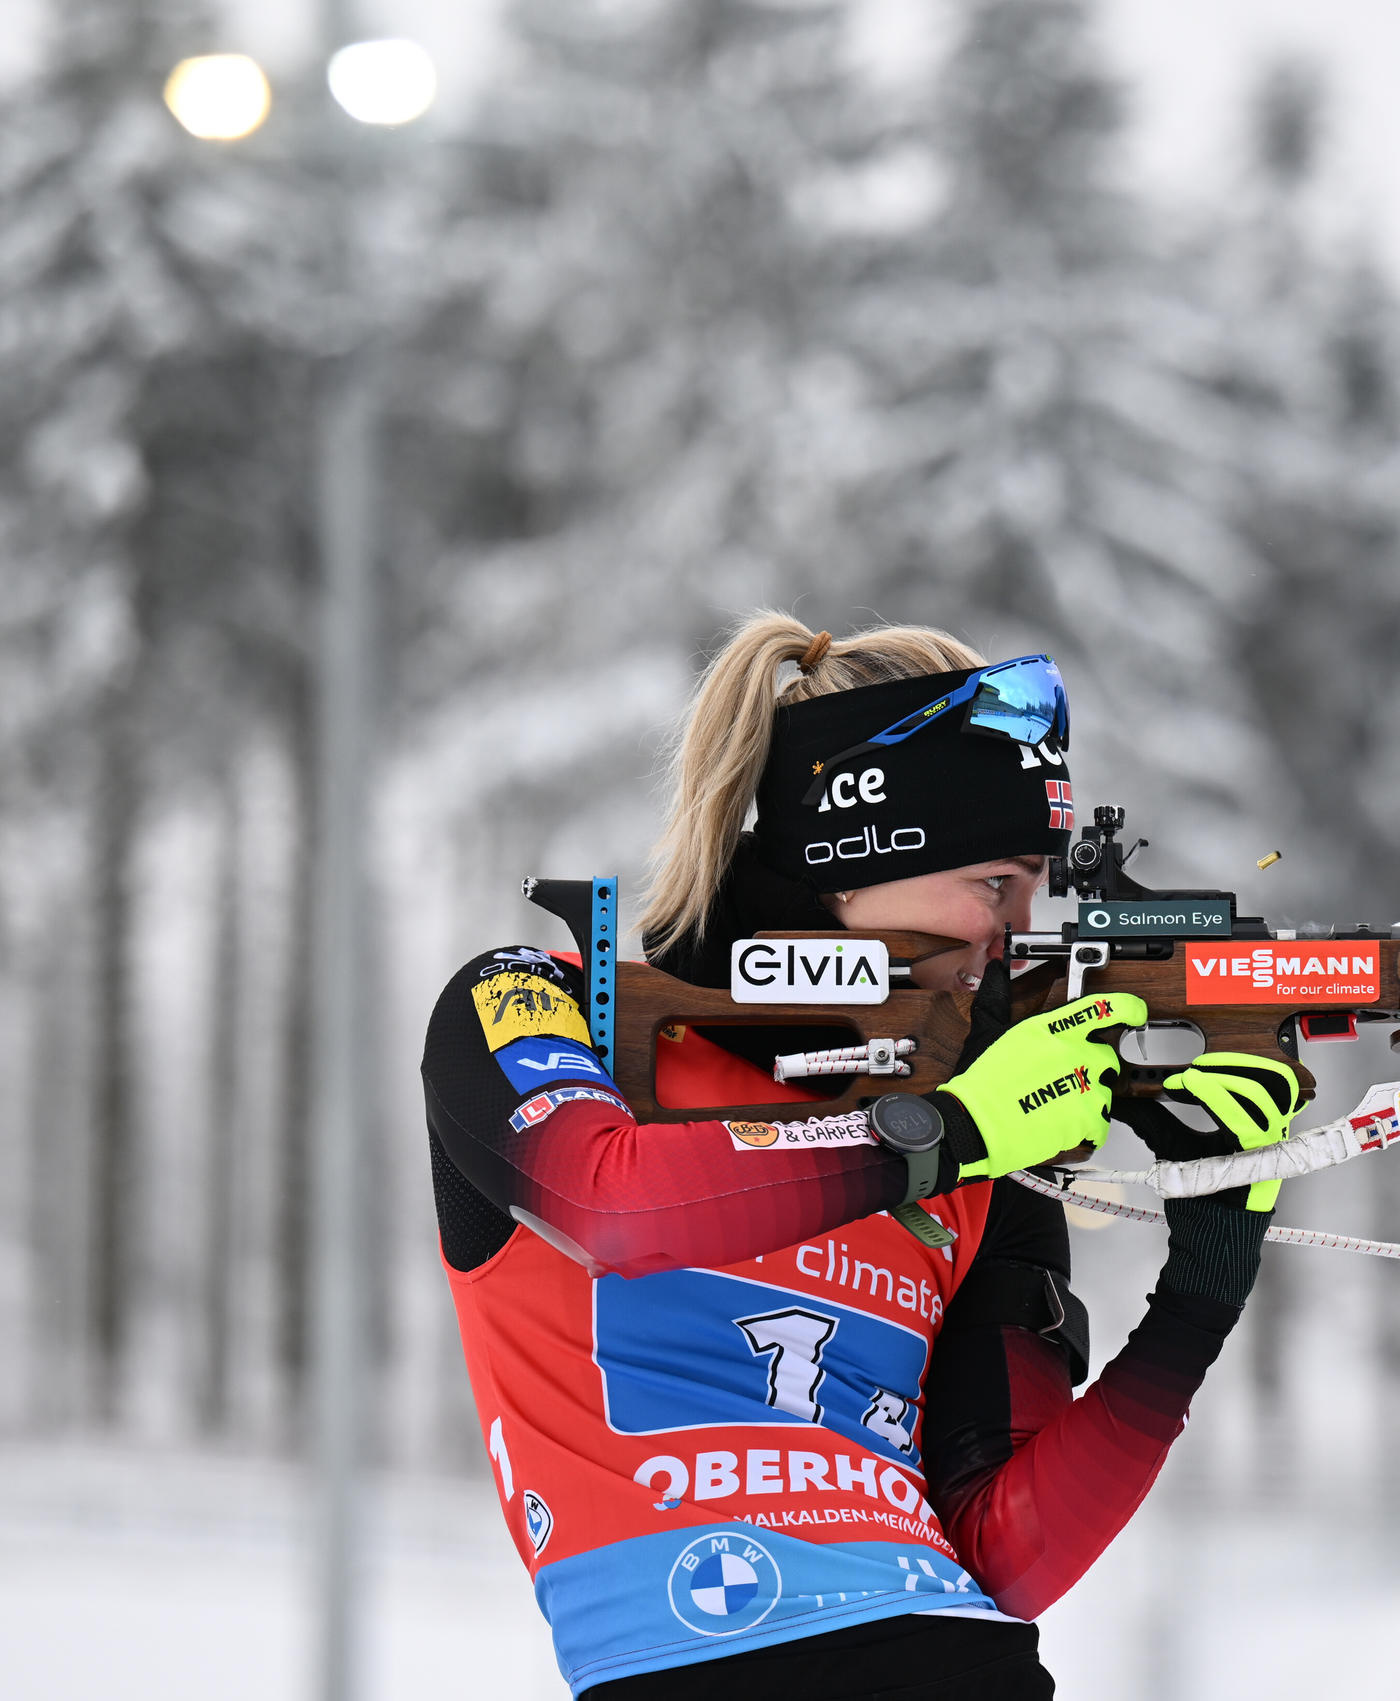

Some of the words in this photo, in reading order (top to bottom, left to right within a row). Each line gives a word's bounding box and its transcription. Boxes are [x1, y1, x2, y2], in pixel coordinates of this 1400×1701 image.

[805, 825, 926, 865] odlo
[1118, 912, 1186, 925] Salmon
[1192, 912, 1223, 929] Eye
[1191, 949, 1374, 988] VIESSMANN
[1276, 983, 1296, 995] for
[1299, 986, 1323, 995] our
[1326, 982, 1375, 995] climate
[784, 1129, 799, 1143] &
[795, 1239, 944, 1325] climate
[732, 1305, 840, 1425] 1
[489, 1415, 515, 1503] 1
[681, 1537, 764, 1572] BMW
